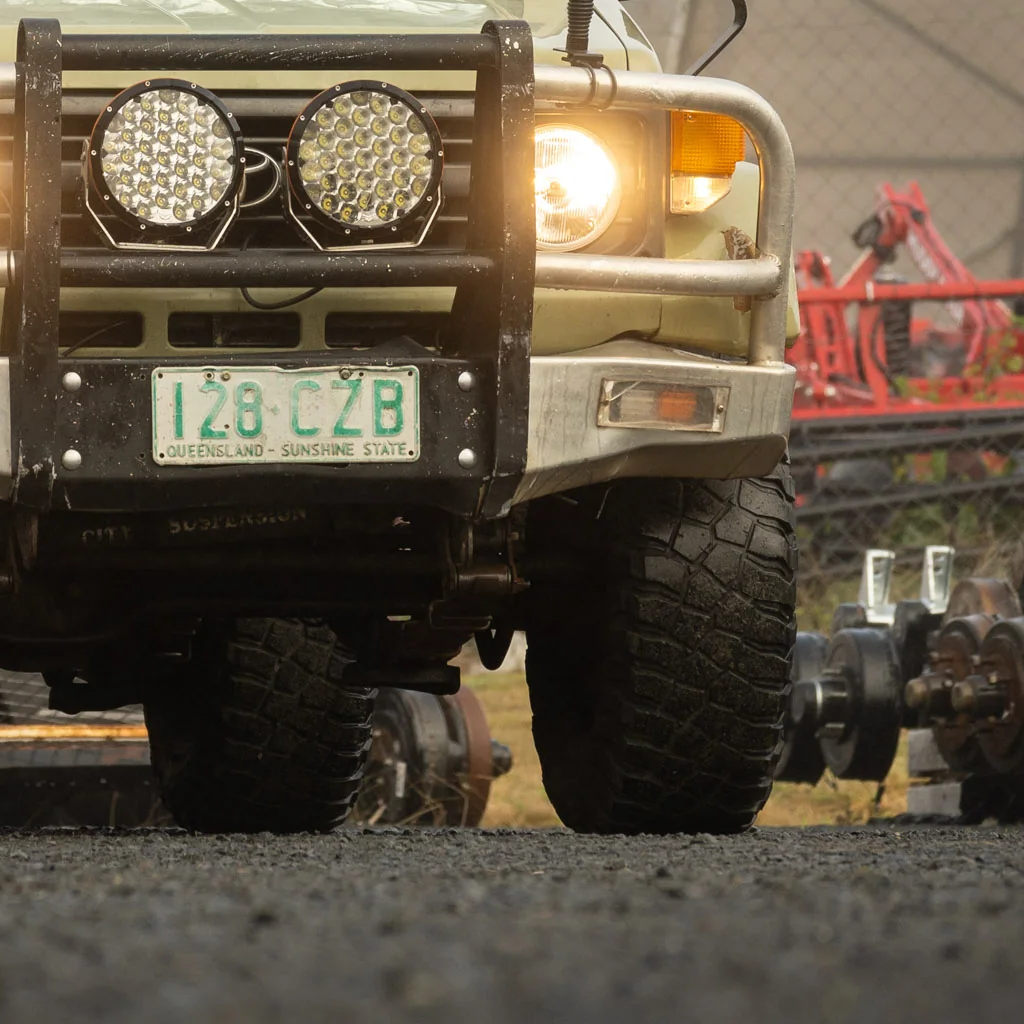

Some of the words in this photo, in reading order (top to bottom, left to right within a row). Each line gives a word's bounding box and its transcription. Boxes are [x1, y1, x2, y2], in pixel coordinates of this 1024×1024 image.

[173, 379, 264, 439] 128
[291, 379, 405, 438] CZB
[166, 443, 264, 458] QUEENSLAND
[280, 442, 355, 457] SUNSHINE
[363, 442, 407, 456] STATE
[168, 509, 307, 535] SUSPENSION
